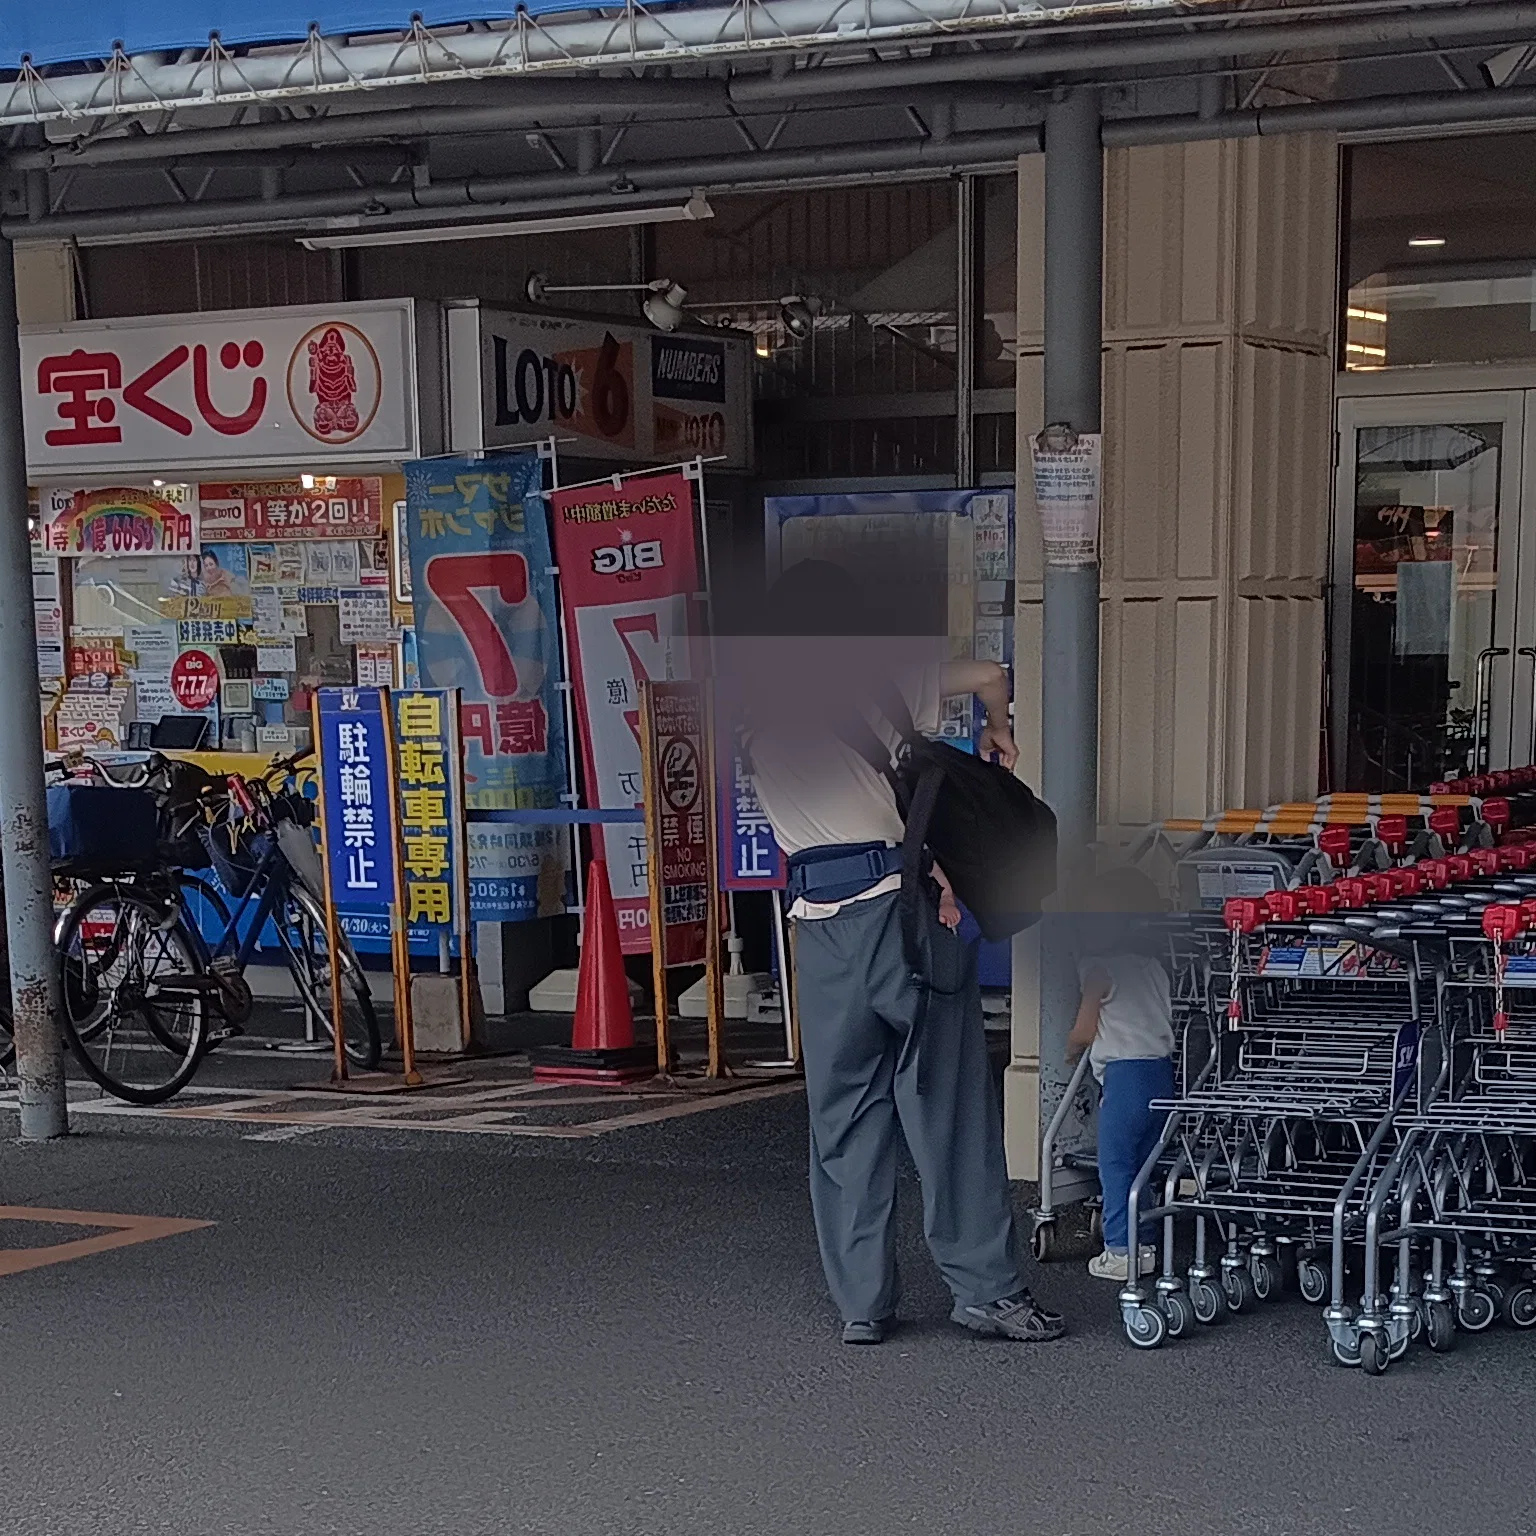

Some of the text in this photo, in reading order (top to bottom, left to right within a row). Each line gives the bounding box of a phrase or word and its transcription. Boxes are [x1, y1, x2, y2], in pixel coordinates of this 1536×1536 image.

[657, 347, 721, 385] NUMBERS
[38, 340, 267, 446] 宝くじ
[492, 330, 629, 437] LOTO 6
[252, 498, 370, 527] 1等が2回!!
[179, 620, 235, 642] 好評発売中
[59, 726, 86, 739] 宝くじ
[338, 722, 378, 888] 駐輪禁止
[397, 693, 452, 924] 自転車専用
[677, 846, 692, 863] NO
[663, 862, 707, 881] SMOKING
